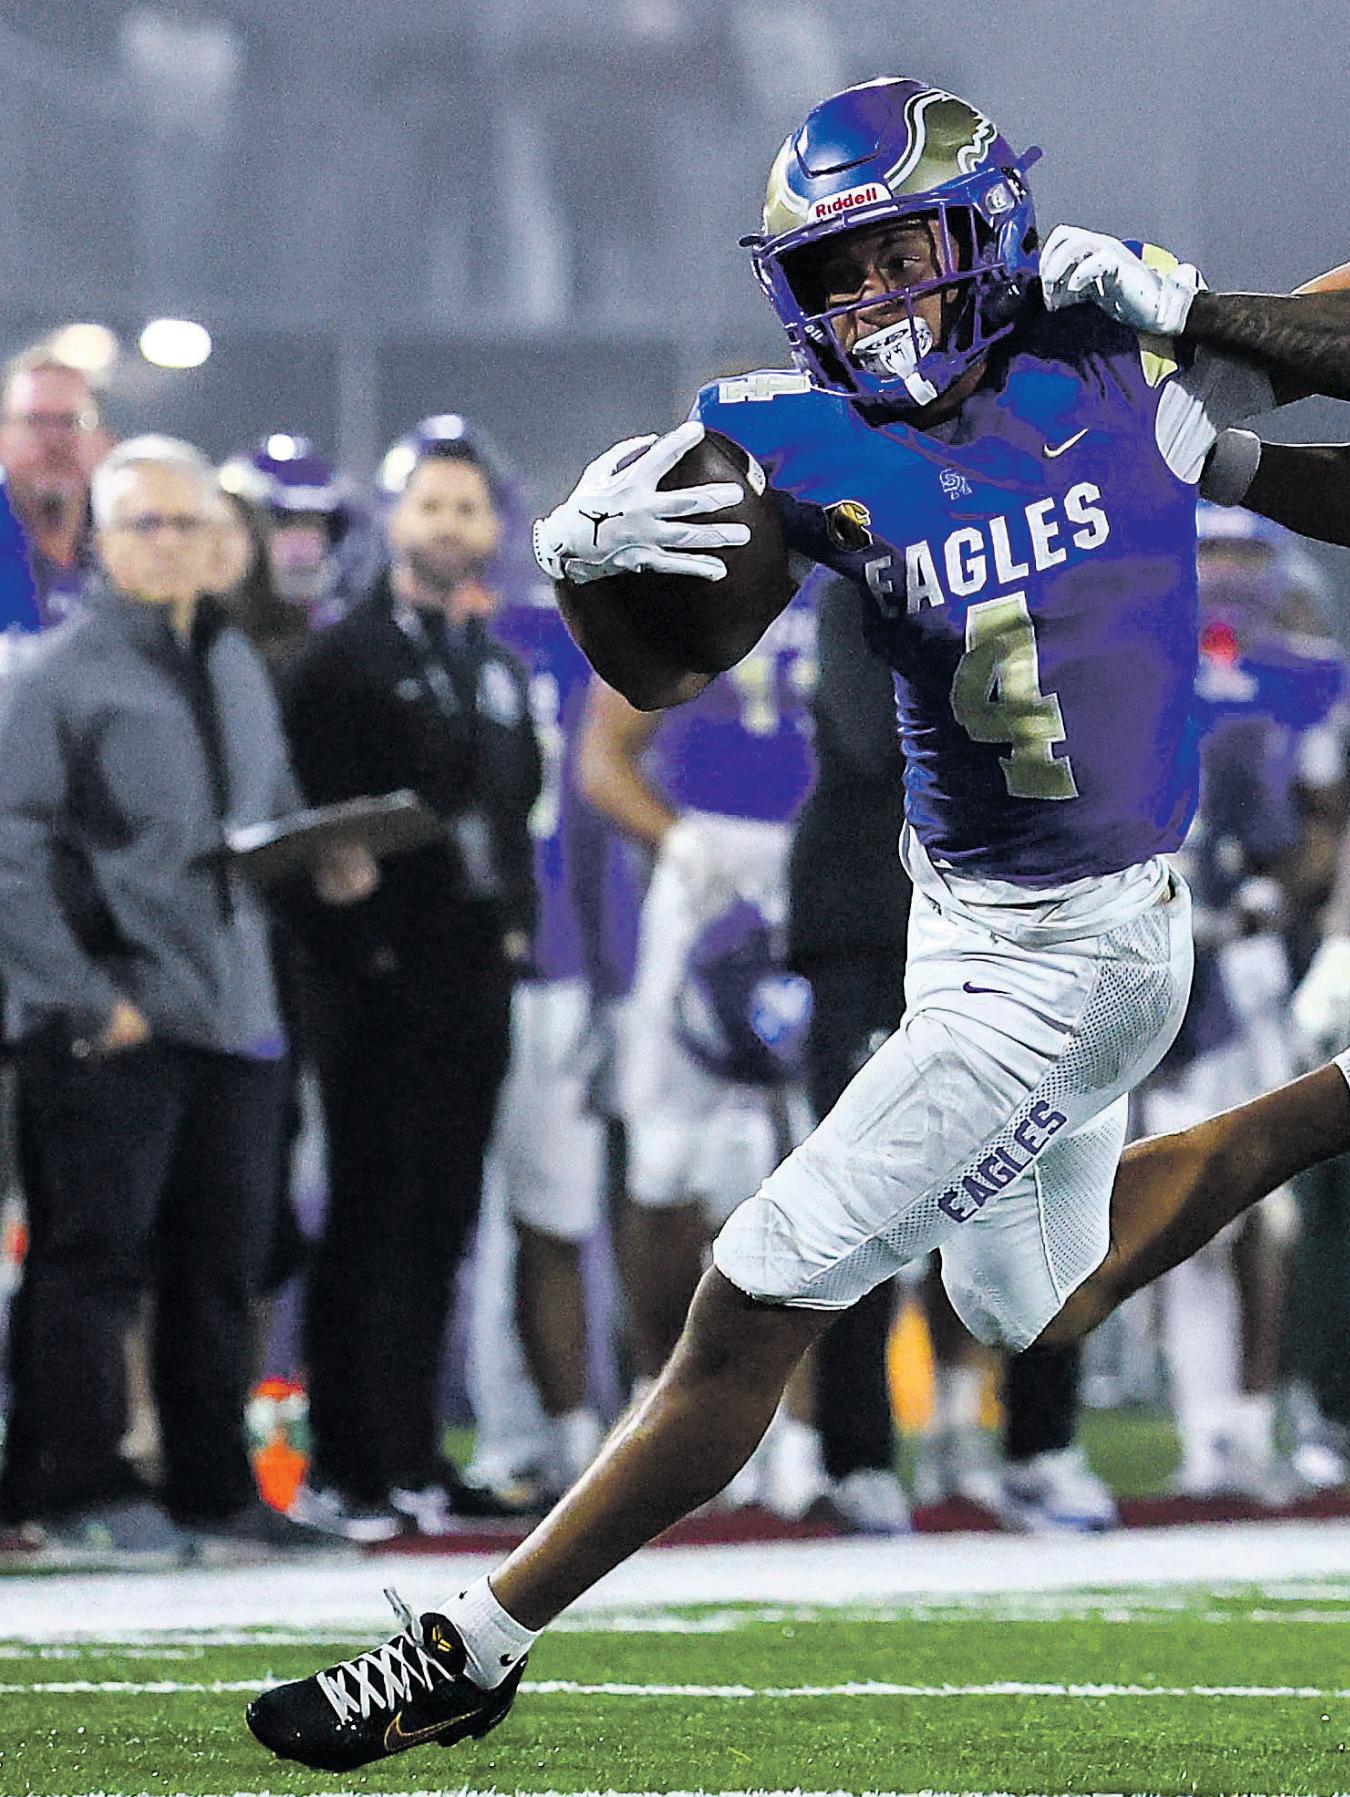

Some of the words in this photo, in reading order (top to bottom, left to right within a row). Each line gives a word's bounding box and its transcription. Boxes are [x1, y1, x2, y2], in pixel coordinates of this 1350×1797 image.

[815, 187, 878, 218] Riddell
[865, 481, 1110, 619] EAGLES
[951, 591, 1080, 800] 4
[937, 1099, 1068, 1224] EAGLES
